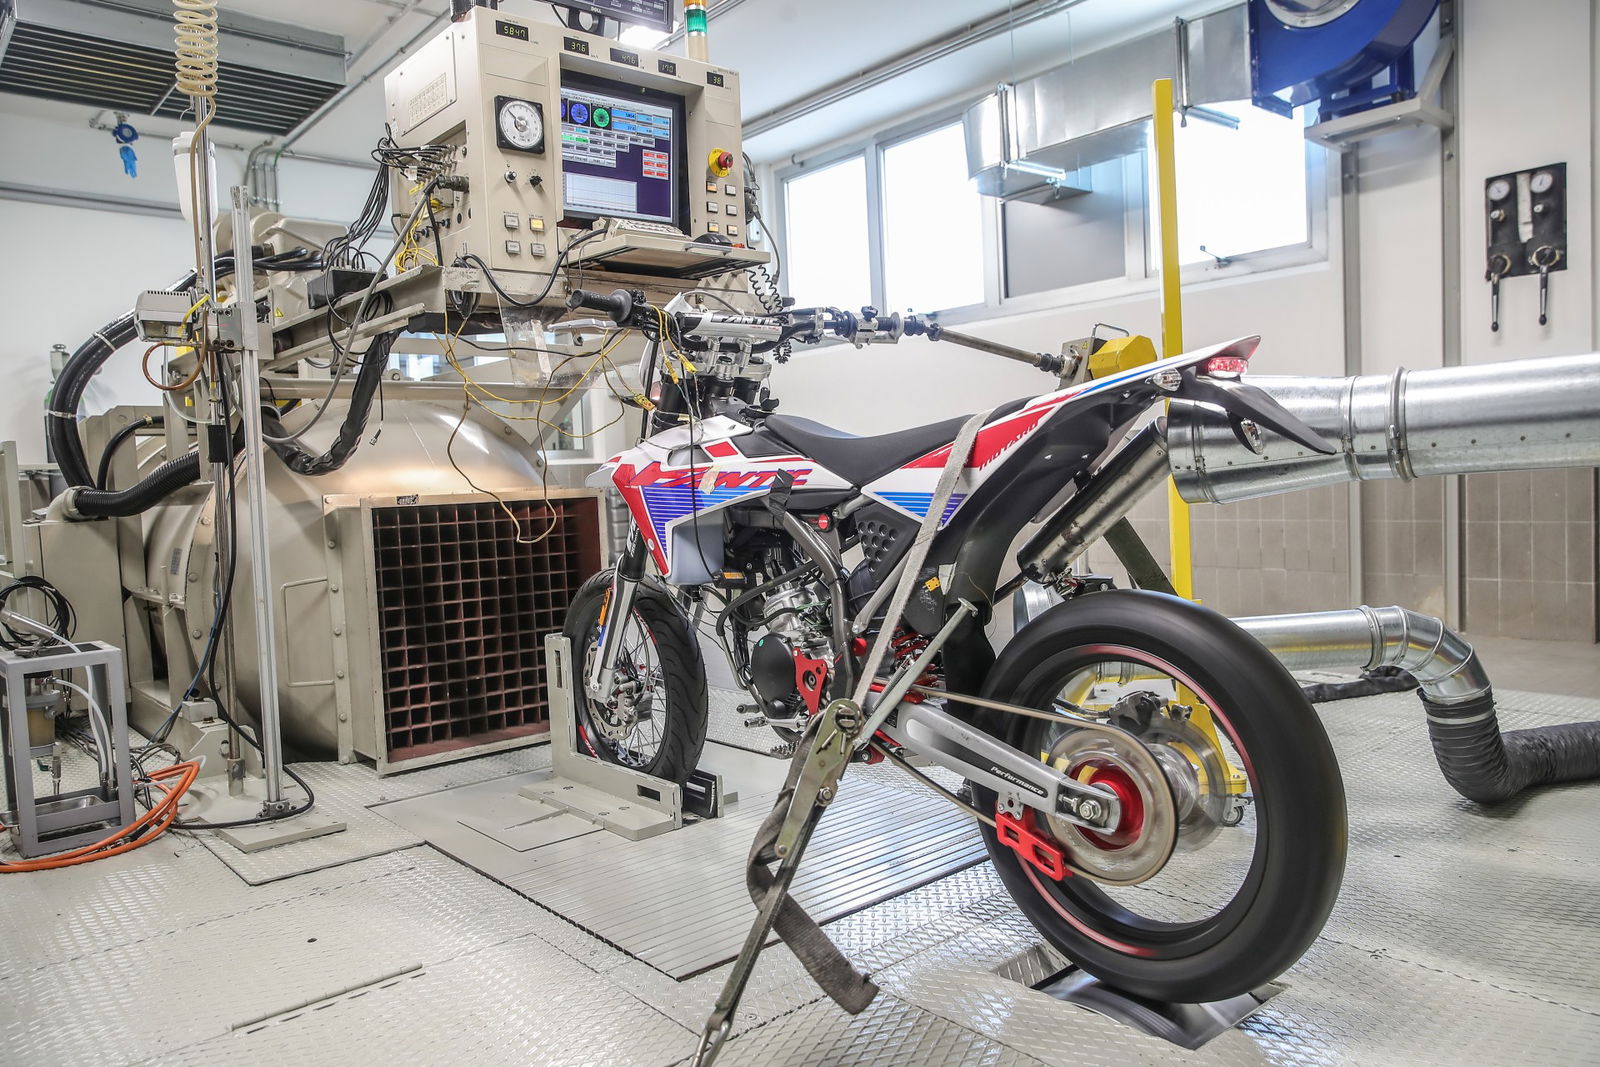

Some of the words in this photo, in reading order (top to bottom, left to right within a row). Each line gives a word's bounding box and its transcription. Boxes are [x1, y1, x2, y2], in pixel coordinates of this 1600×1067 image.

[504, 25, 526, 37] 5847
[711, 313, 782, 326] FANTIC
[629, 461, 813, 489] FANTC
[990, 765, 1044, 795] Performance
